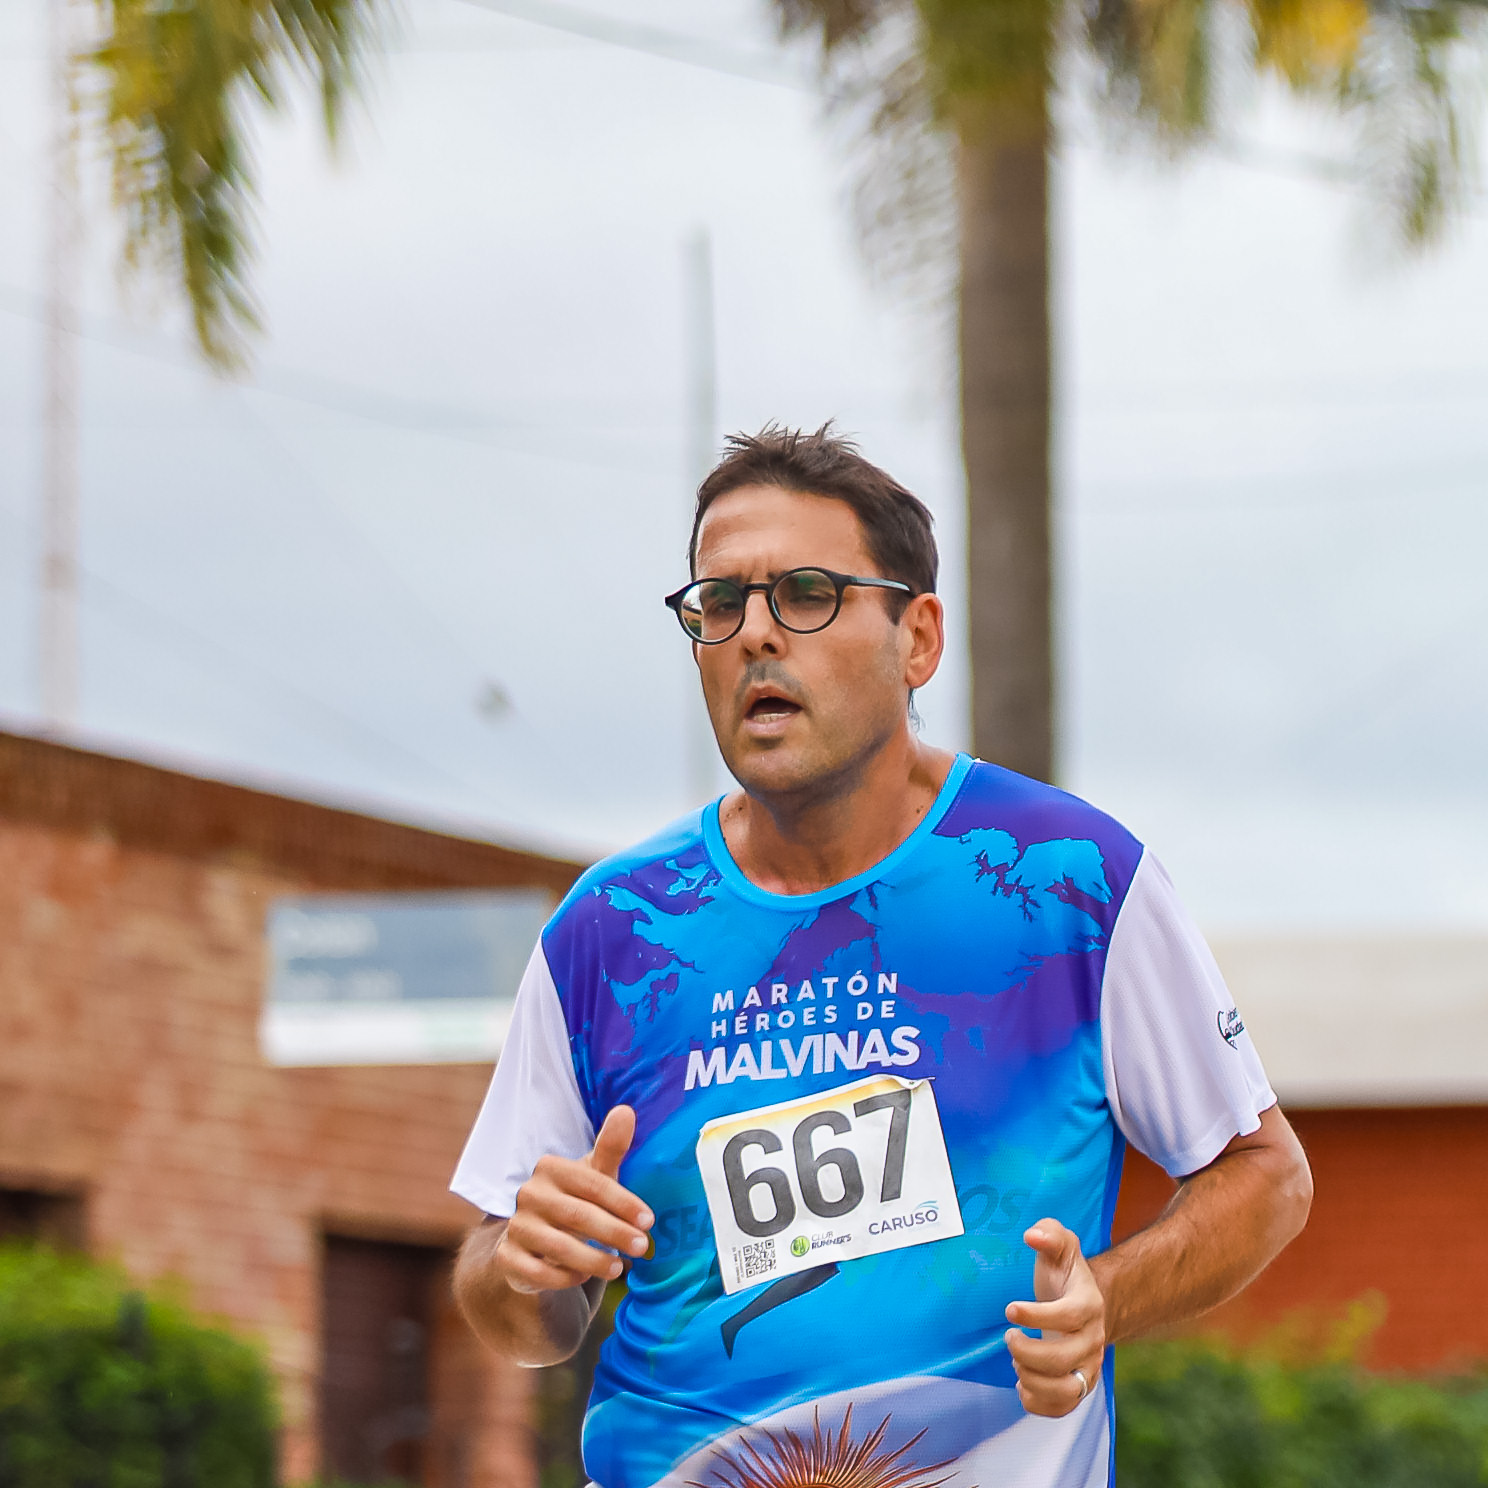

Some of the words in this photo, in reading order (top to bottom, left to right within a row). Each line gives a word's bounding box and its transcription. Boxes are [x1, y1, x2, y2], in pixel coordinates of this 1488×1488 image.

[711, 969, 898, 1014] MARATÓN
[711, 1004, 838, 1039] HÉROES
[856, 1000, 896, 1021] DE
[684, 1025, 921, 1091] MALVINAS
[722, 1088, 912, 1238] 667
[868, 1209, 939, 1236] CARUSO
